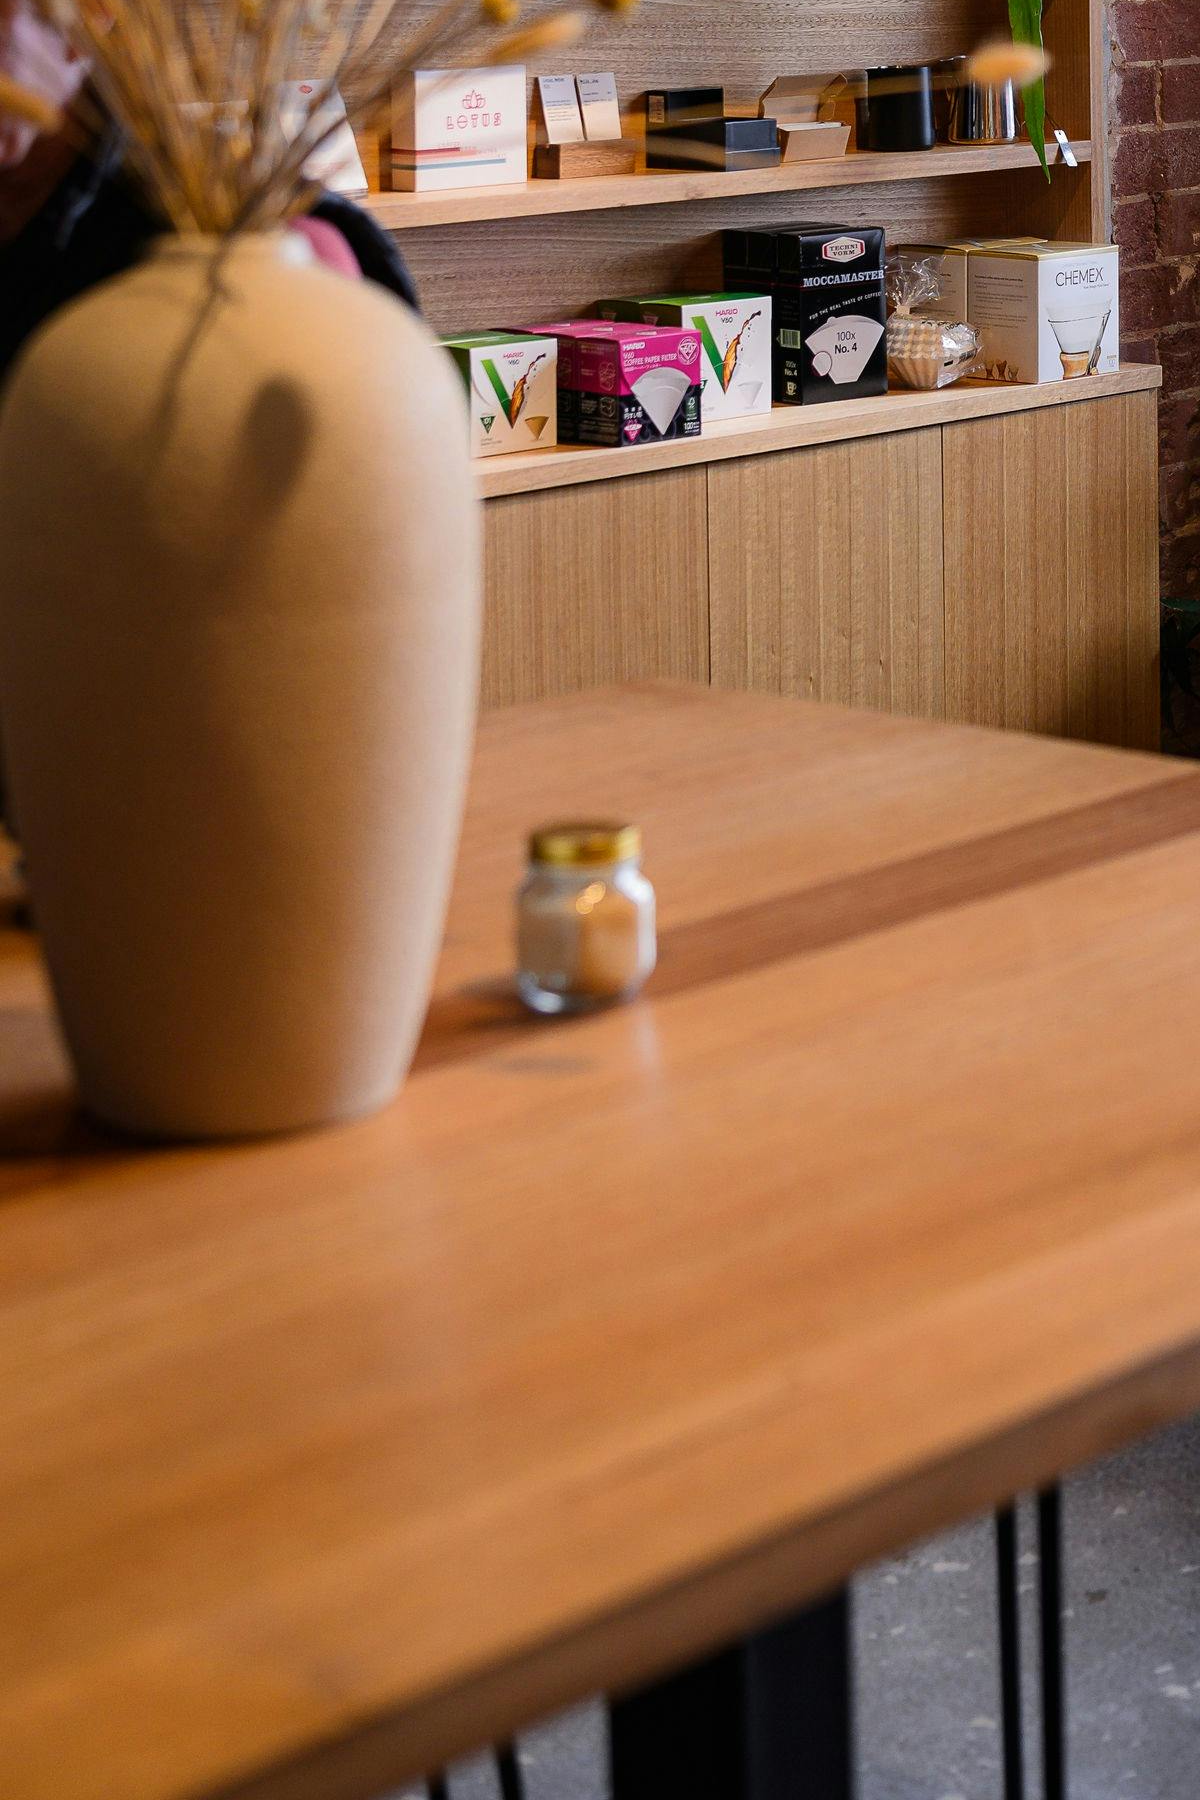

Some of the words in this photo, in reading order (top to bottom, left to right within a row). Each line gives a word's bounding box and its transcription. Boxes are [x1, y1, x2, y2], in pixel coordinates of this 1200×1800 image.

[447, 112, 502, 130] LOTUS
[830, 244, 858, 252] TECHNI
[803, 270, 885, 287] MOCCAMASTER
[1055, 267, 1104, 287] CHEMEX
[715, 308, 738, 316] HARIO
[809, 312, 819, 320] FOR
[829, 303, 841, 311] REAL
[842, 298, 856, 306] TASTE
[837, 330, 856, 341] 100x
[623, 342, 645, 351] HARIO
[834, 344, 850, 354] No.
[851, 342, 858, 352] 4
[624, 357, 644, 367] COFFEE
[645, 355, 661, 364] PAPER
[661, 353, 678, 362] FILTER
